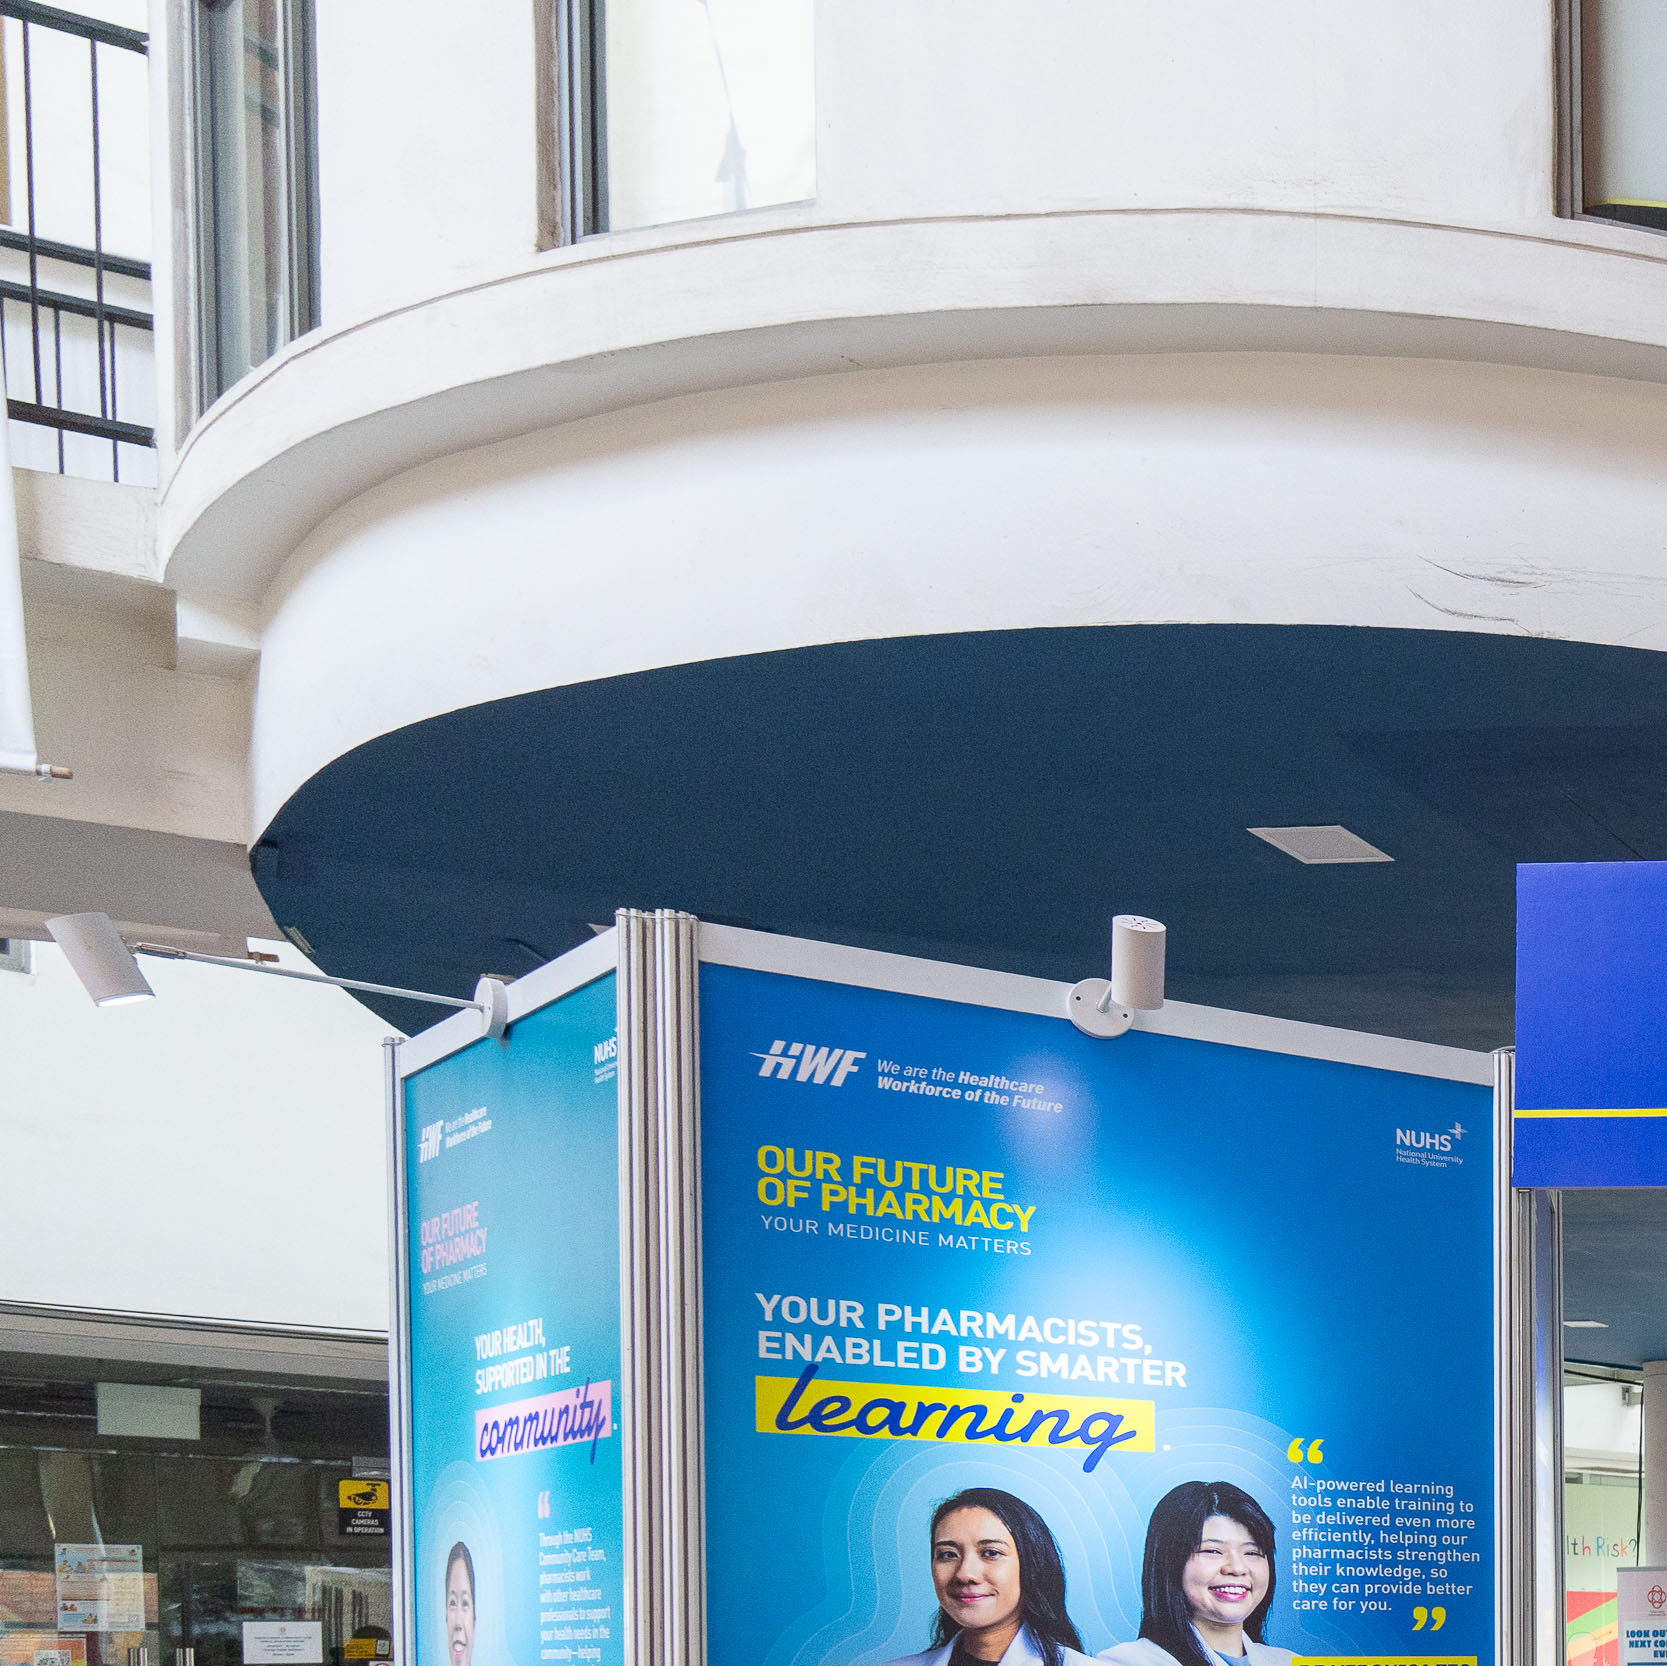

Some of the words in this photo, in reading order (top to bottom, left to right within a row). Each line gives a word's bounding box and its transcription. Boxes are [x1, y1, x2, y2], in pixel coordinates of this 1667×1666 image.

[594, 1037, 617, 1064] NUHS
[750, 1040, 867, 1087] HWF
[877, 1059, 900, 1074] We
[903, 1065, 928, 1078] are
[931, 1067, 955, 1082] the
[958, 1072, 1044, 1094] Healthcare
[877, 1076, 961, 1099] Workforce
[964, 1088, 983, 1102] of
[984, 1092, 1009, 1106] the
[1013, 1095, 1063, 1113] Future
[1396, 1128, 1451, 1151] NUHS
[757, 1145, 841, 1182] OUR
[853, 1155, 1005, 1200] FUTURE
[421, 1217, 440, 1246] OUR
[441, 1201, 479, 1240] FUTURE
[757, 1176, 811, 1208] OF
[821, 1183, 1036, 1233] PHARMACY
[422, 1247, 433, 1274] OF
[435, 1227, 487, 1270] PHARMACY
[761, 1215, 819, 1235] YOUR
[828, 1222, 930, 1246] MEDICINE
[939, 1233, 1032, 1256] MATTERS
[475, 1330, 501, 1360] YOUR
[503, 1318, 545, 1353] HEALTH,
[755, 1293, 865, 1329] YOUR
[877, 1303, 1153, 1356] PHARMACISTS,
[475, 1355, 534, 1395] SUPPORTED
[536, 1352, 546, 1379] IN
[550, 1346, 570, 1376] THE
[758, 1331, 946, 1370] ENABLED
[959, 1345, 1007, 1375] BY
[1015, 1350, 1188, 1388] SMARTER
[1596, 1536, 1637, 1557] Risk?
[1626, 1629, 1649, 1638] LOOK
[1629, 1640, 1651, 1648] NEXT
